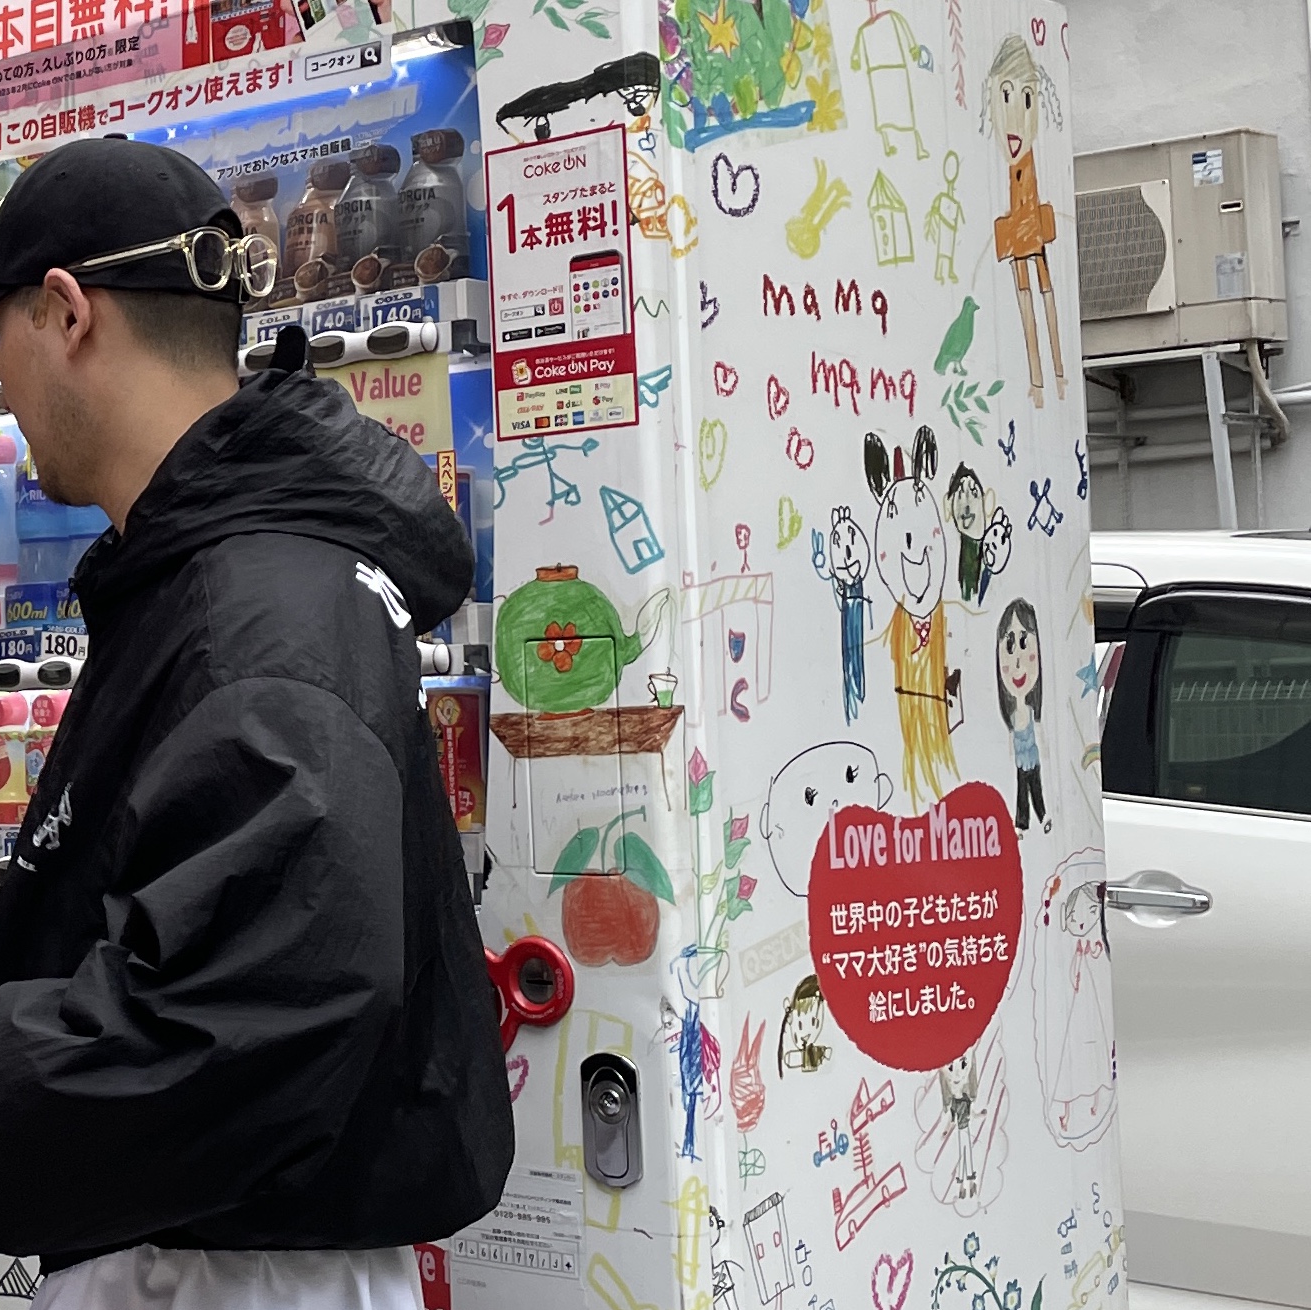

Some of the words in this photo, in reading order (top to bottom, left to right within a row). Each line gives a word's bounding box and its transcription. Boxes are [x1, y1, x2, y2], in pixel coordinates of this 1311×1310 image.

[311, 53, 356, 72] コークオン
[523, 161, 561, 179] Coke
[564, 154, 587, 171] ON
[542, 181, 617, 206] スタンプたまると
[496, 193, 620, 254] 1本無料!
[375, 292, 413, 304] COLD
[259, 314, 291, 325] COLD
[534, 363, 567, 379] Coke
[568, 359, 588, 374] ON
[589, 358, 616, 373] Pay
[350, 368, 422, 403] Value
[512, 420, 531, 430] VISA
[7, 600, 49, 623] 600ml
[828, 808, 887, 870] Love
[893, 816, 924, 864] for
[928, 801, 1001, 862] Mama
[829, 888, 999, 936] 世界中の子どもたちが
[868, 980, 976, 1024] 絵にしました。
